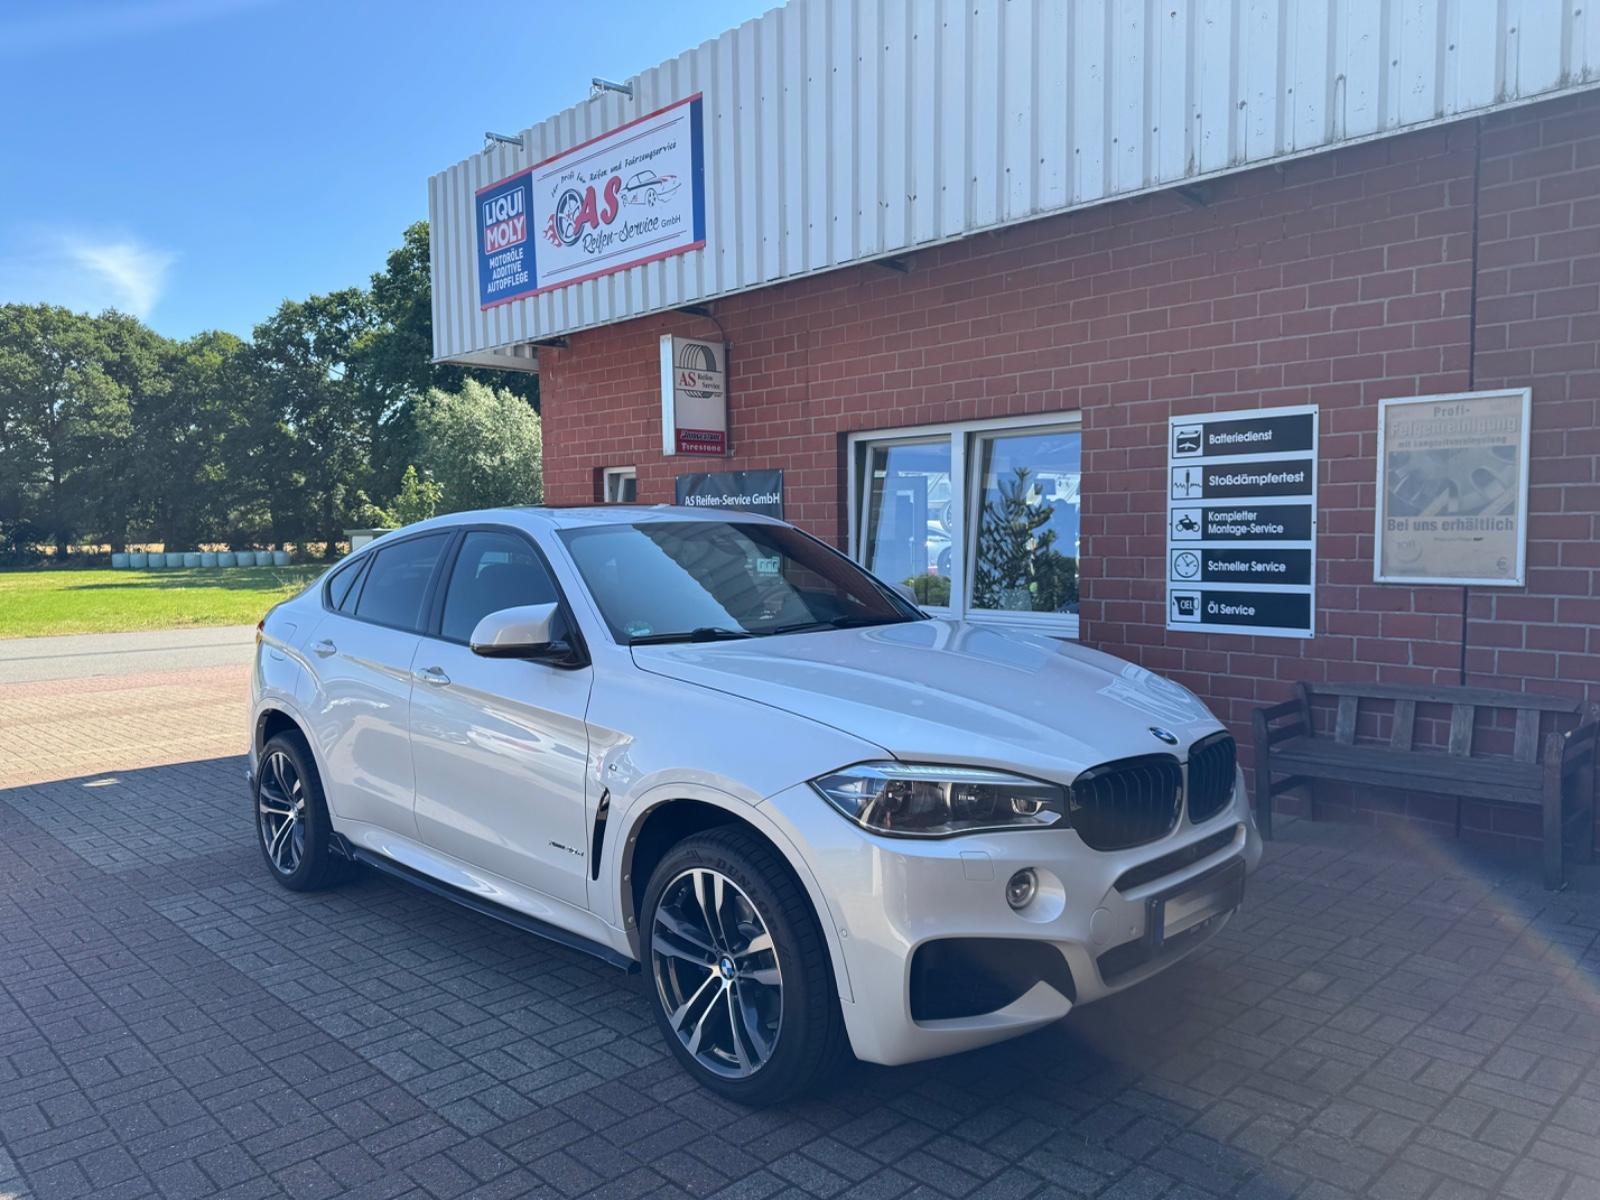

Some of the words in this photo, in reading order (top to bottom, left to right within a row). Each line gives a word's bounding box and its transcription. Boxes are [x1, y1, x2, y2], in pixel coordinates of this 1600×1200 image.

[610, 160, 622, 174] und
[625, 141, 677, 168] Fahrzeugservice
[485, 190, 523, 226] LIQUI
[574, 175, 622, 236] AS
[486, 216, 524, 251] MOLY
[582, 216, 660, 254] Reifen-Service
[661, 214, 681, 228] GmbH
[489, 247, 524, 269] MOTORÖLE
[492, 261, 522, 280] ADDITIVE
[487, 271, 529, 294] AUTOPFLEGE
[679, 371, 697, 388] AS
[1433, 405, 1470, 418] Profi-
[1209, 429, 1273, 445] Batteriedienst
[681, 442, 721, 453] Firestone
[1209, 471, 1304, 487] Stoßdämpfertest
[685, 495, 695, 506] AS
[696, 494, 750, 506] Reifen-Service
[752, 492, 780, 504] GmbH
[1208, 511, 1258, 523] Kompletter
[1387, 519, 1409, 532] Bei
[1413, 520, 1437, 532] uns
[1441, 517, 1513, 531] erhältlich
[1208, 523, 1284, 536] Montage-Service
[1208, 560, 1249, 571] Schneller
[1251, 562, 1286, 573] Service
[1180, 599, 1193, 610] OEL
[1208, 601, 1218, 614] Öl
[1220, 604, 1255, 616] Service
